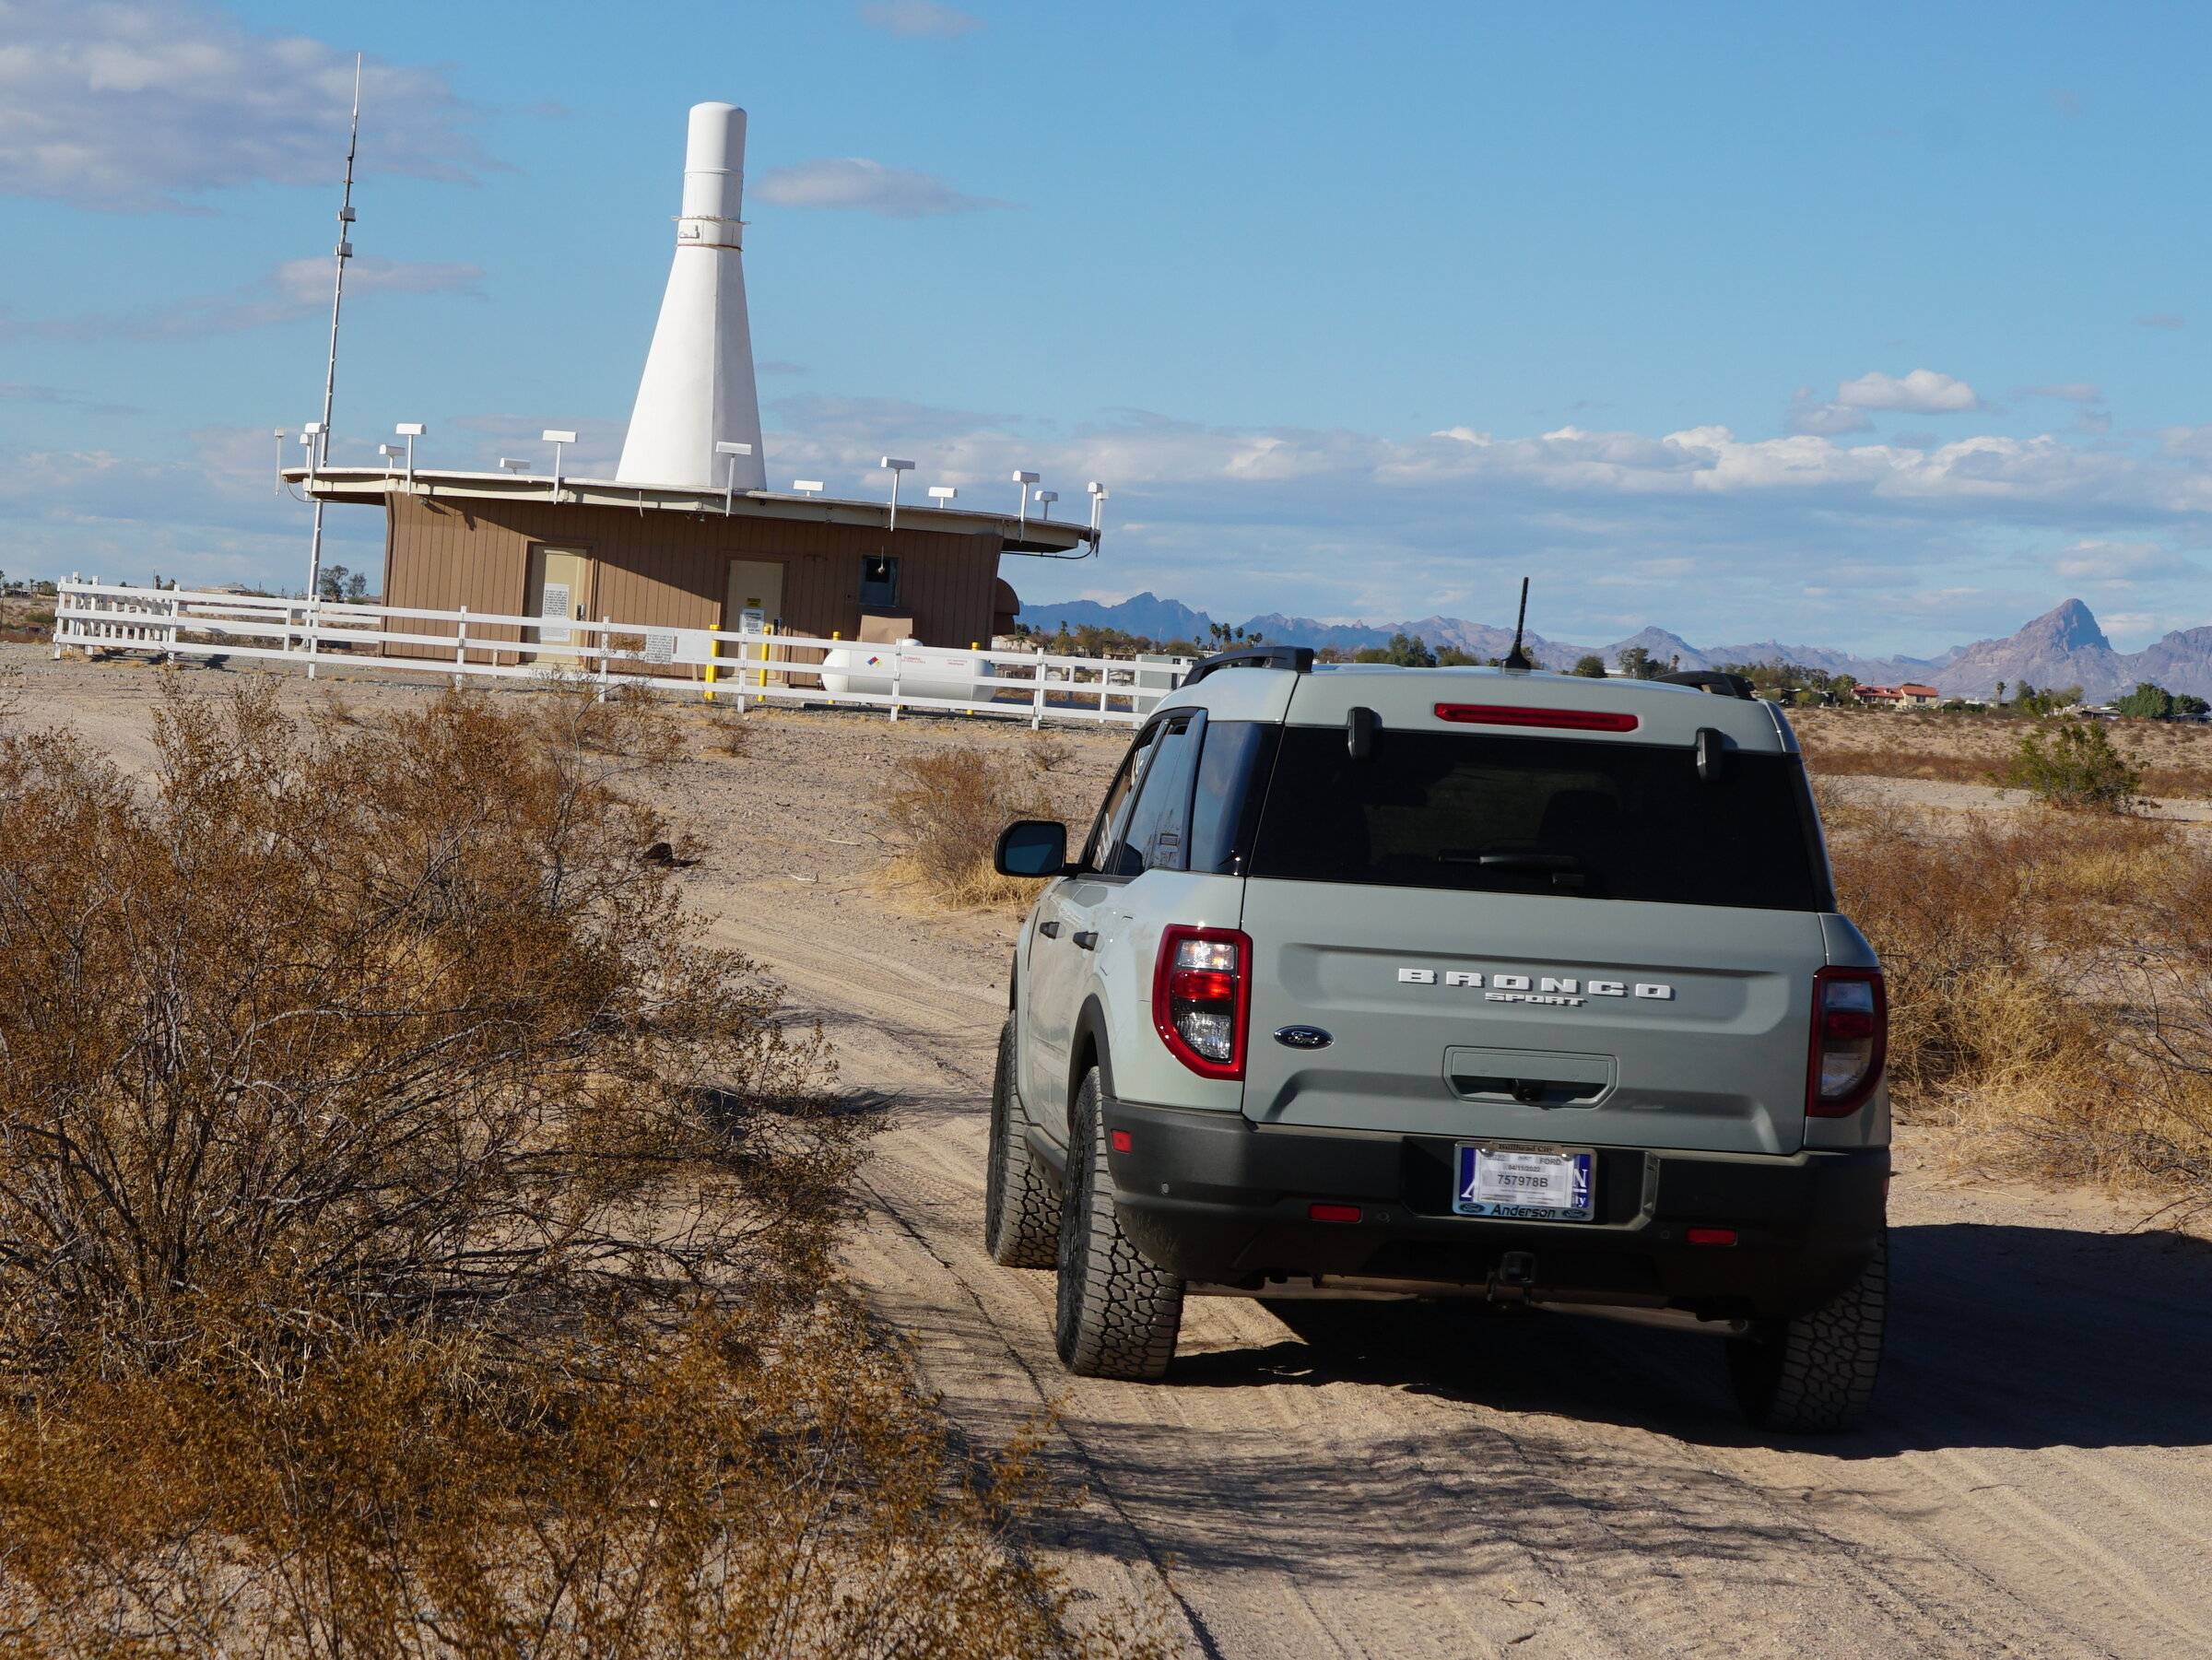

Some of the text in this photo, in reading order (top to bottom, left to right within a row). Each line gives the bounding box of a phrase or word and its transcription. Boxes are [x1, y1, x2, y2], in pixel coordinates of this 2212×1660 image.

[1398, 968, 1673, 999] BRONCO
[1485, 993, 1585, 1006] SPORT
[1539, 1158, 1562, 1166] FORD
[1498, 1174, 1548, 1188] 757978B
[1490, 1205, 1556, 1218] Anderson
